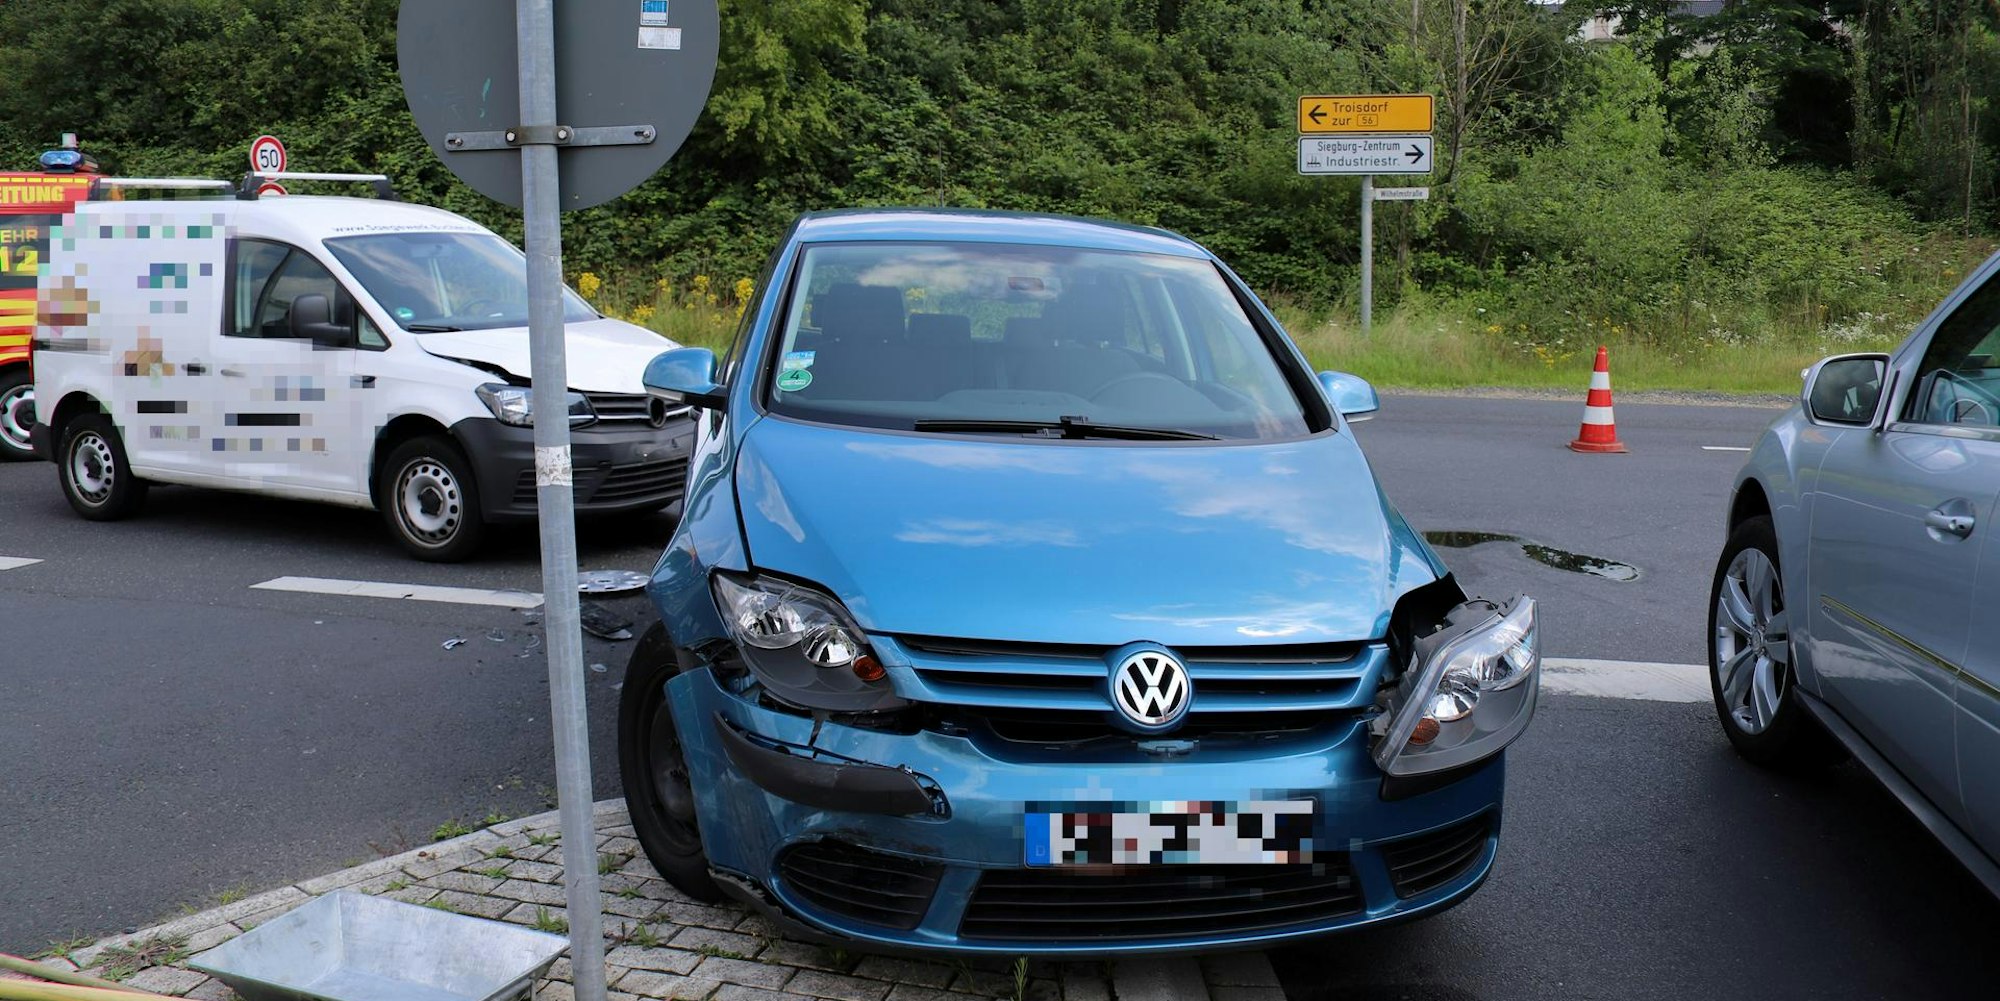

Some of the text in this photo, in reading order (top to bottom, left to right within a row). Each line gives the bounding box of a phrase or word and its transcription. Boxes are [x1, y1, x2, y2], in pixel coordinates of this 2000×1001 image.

[1332, 102, 1389, 113] Troisdorf
[1332, 116, 1373, 126] zur 56
[1317, 140, 1401, 154] Siegburg-Zentrum
[260, 149, 279, 168] 50
[1326, 156, 1401, 167] Industriestr.
[0, 185, 64, 204] ITUNG
[790, 370, 801, 380] 4
[1114, 652, 1188, 725] VW
